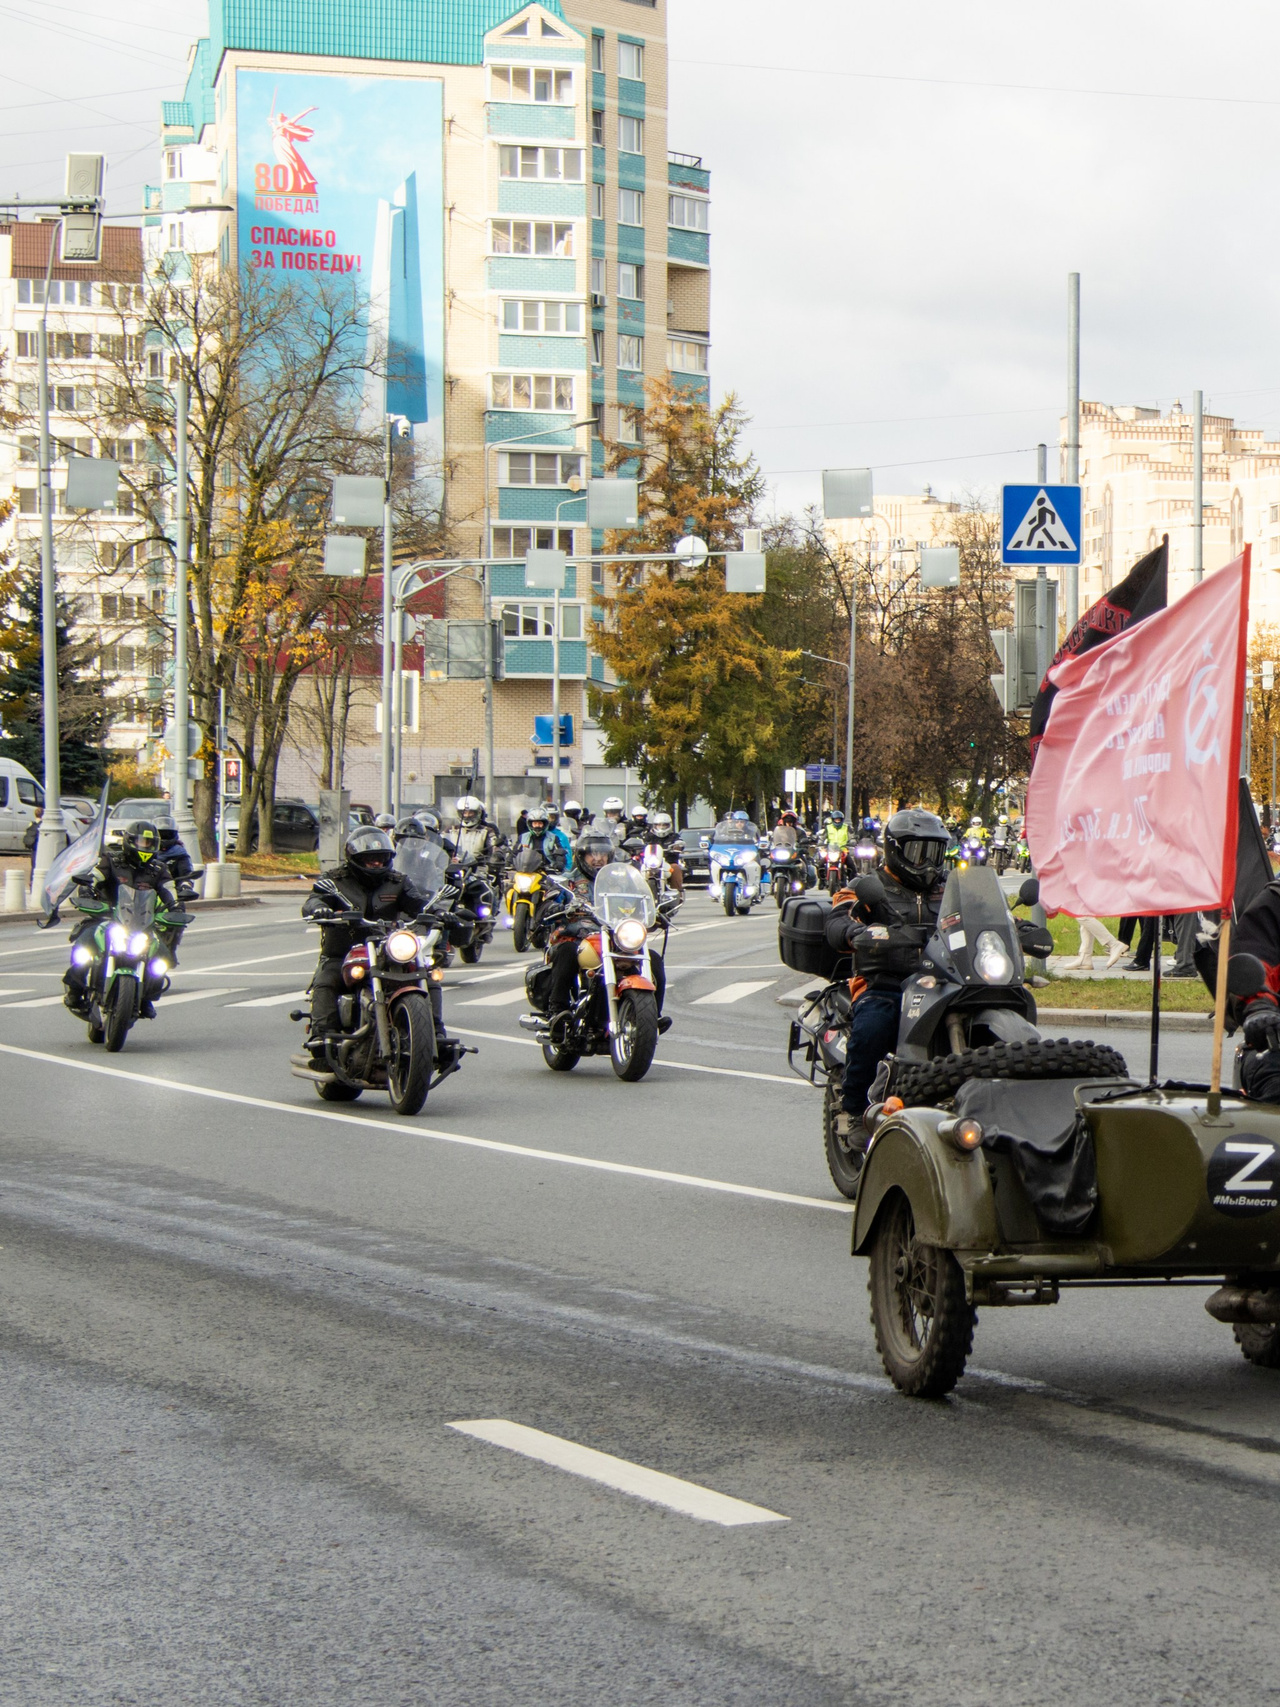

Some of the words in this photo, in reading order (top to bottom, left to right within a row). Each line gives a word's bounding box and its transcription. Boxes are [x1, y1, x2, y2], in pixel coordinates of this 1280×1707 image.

[254, 163, 289, 192] 80
[254, 196, 319, 215] ПОБЕДА!
[250, 226, 336, 248] СПАСИБО
[250, 249, 276, 269] ЗА
[281, 252, 362, 275] ПОБЕДУ!
[1224, 1142, 1276, 1191] Z
[1213, 1195, 1278, 1207] #МыВместе
